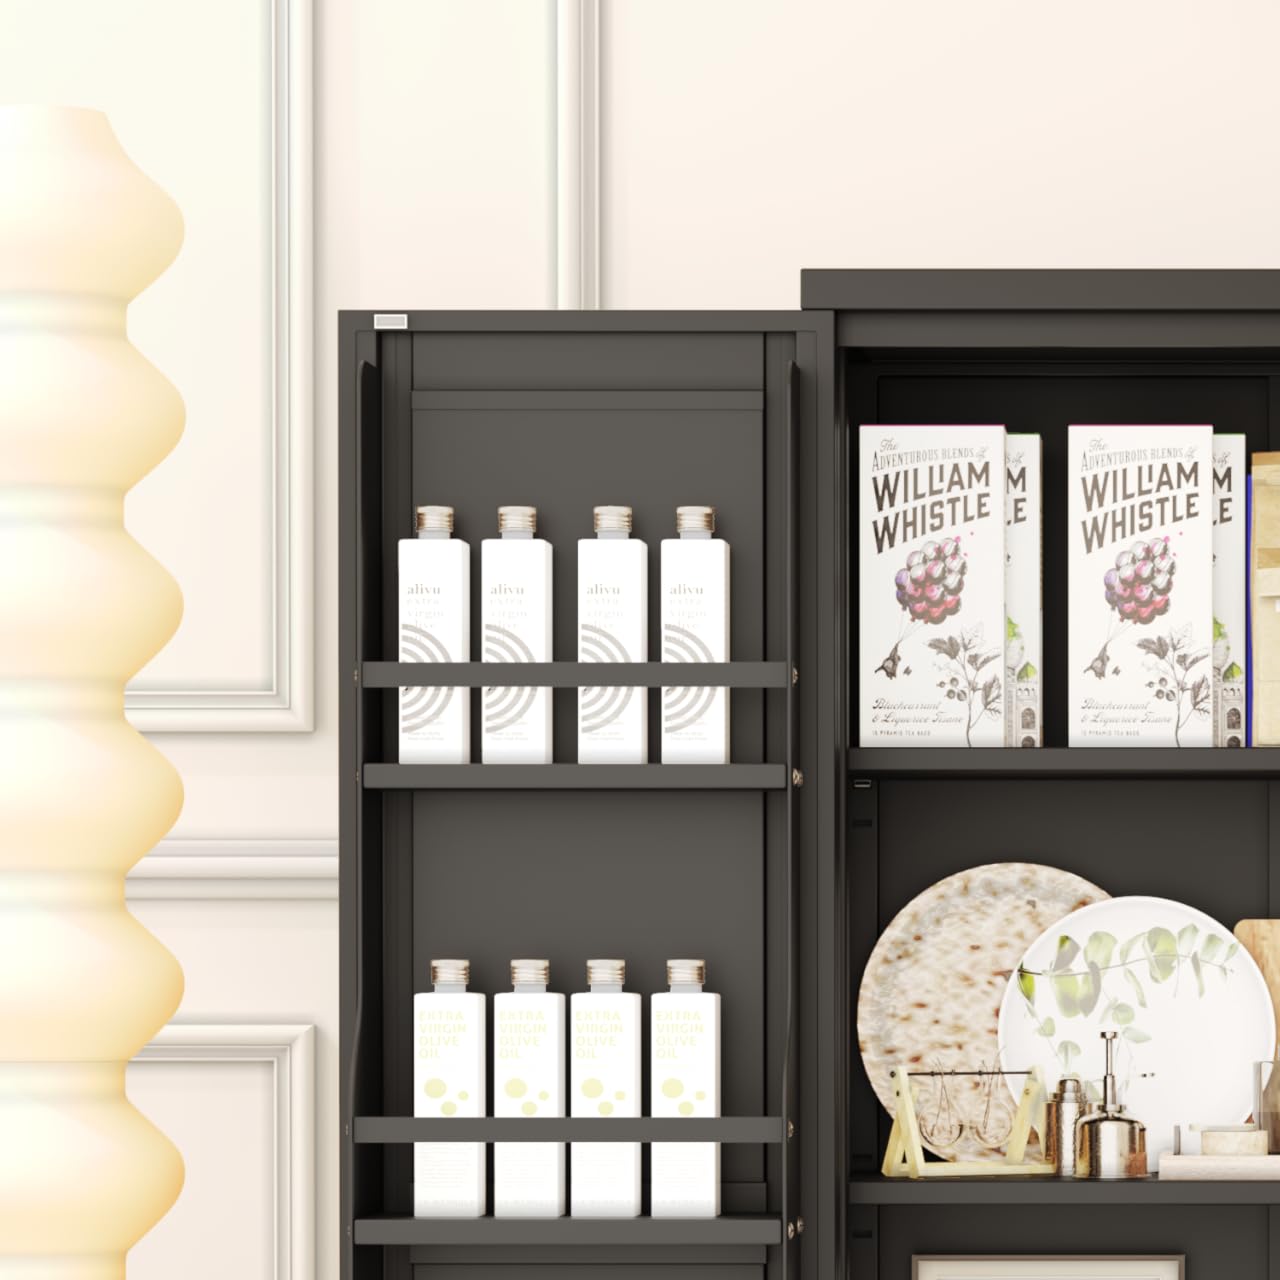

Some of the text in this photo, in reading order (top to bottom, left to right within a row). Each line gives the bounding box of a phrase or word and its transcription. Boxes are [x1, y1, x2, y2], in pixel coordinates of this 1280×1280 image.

[872, 461, 990, 512] WILLIAM
[1081, 461, 1199, 512] WILLIAM
[872, 493, 990, 554] WHISTLE
[1081, 493, 1199, 554] WHISTLE
[407, 583, 441, 596] alivu
[490, 583, 525, 596] alivu
[586, 583, 620, 596] alivu
[670, 583, 704, 596] alivu
